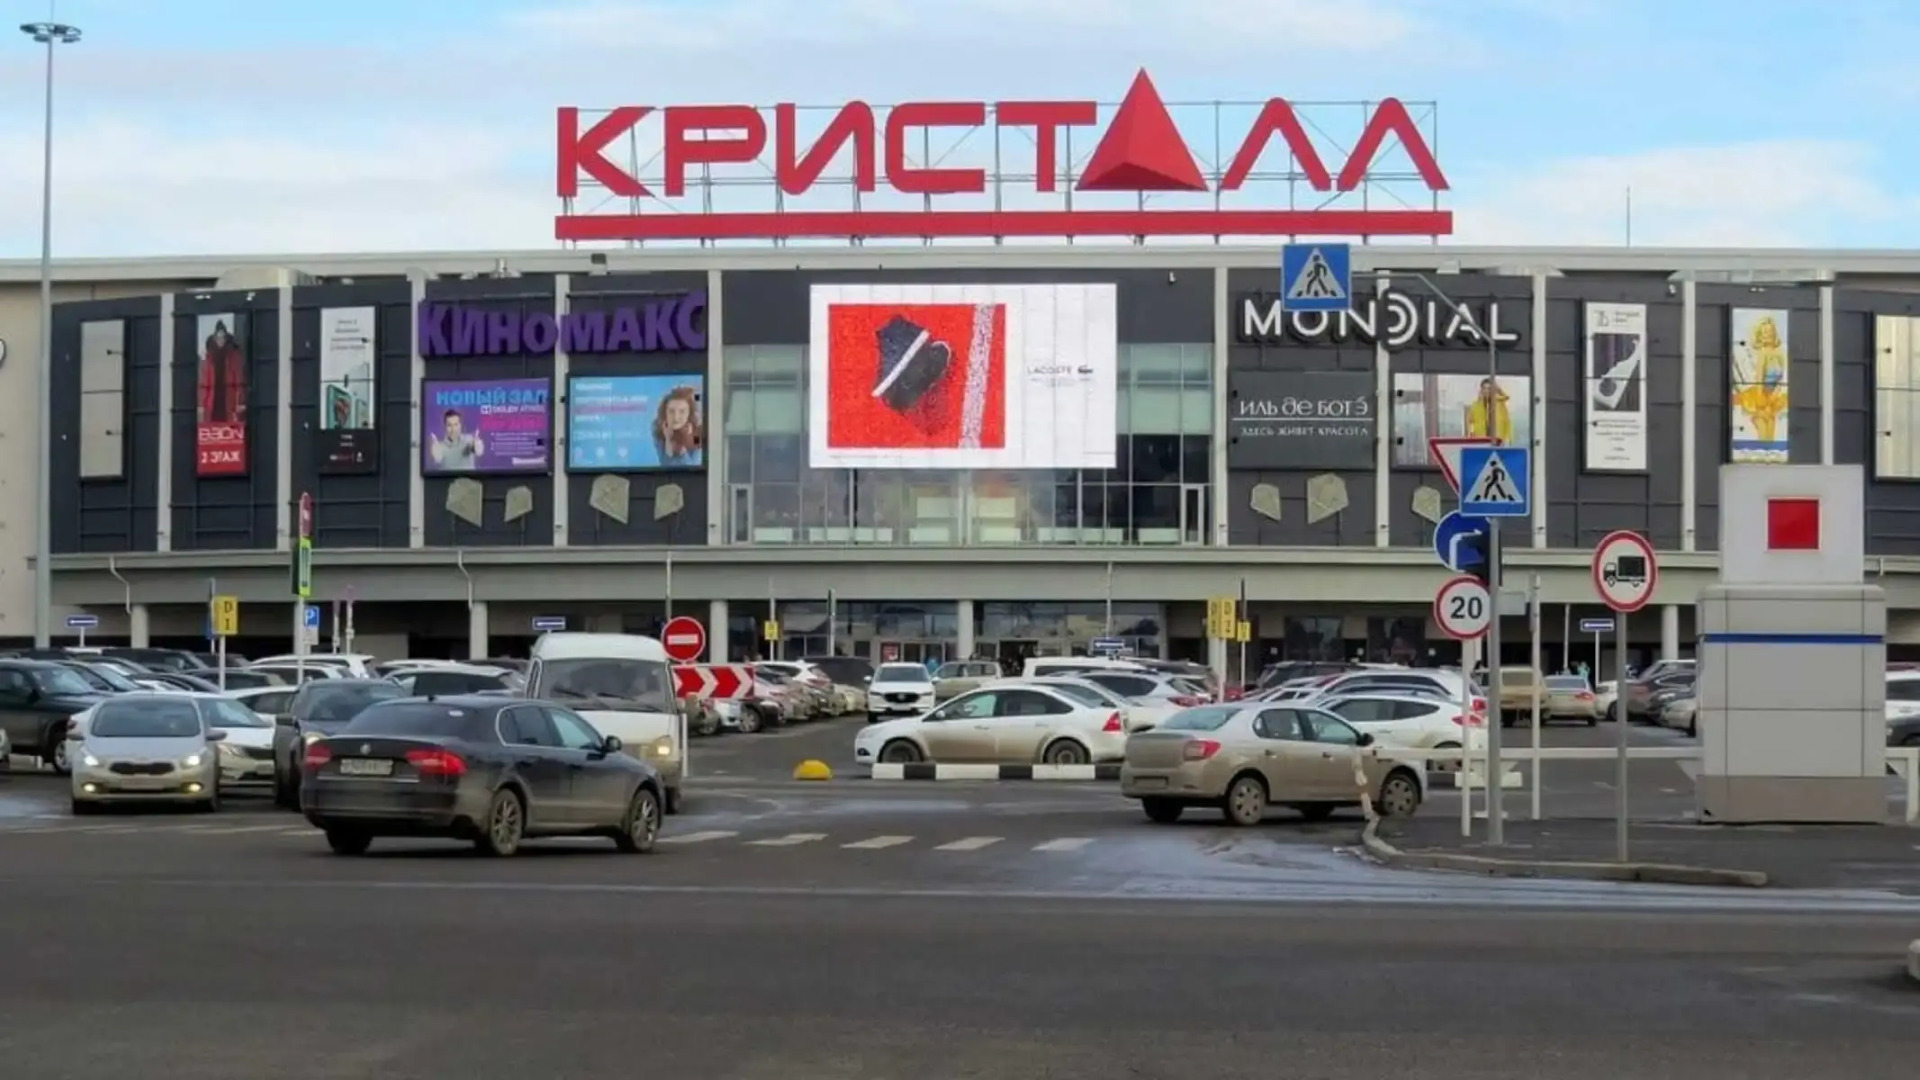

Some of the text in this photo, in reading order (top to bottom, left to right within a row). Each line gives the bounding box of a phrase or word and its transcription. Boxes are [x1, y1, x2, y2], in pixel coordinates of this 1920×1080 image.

[418, 290, 708, 358] КИНОМАКС
[1244, 293, 1518, 345] MONDIAL
[1240, 400, 1278, 416] ИЛЬ
[1450, 596, 1483, 620] 20
